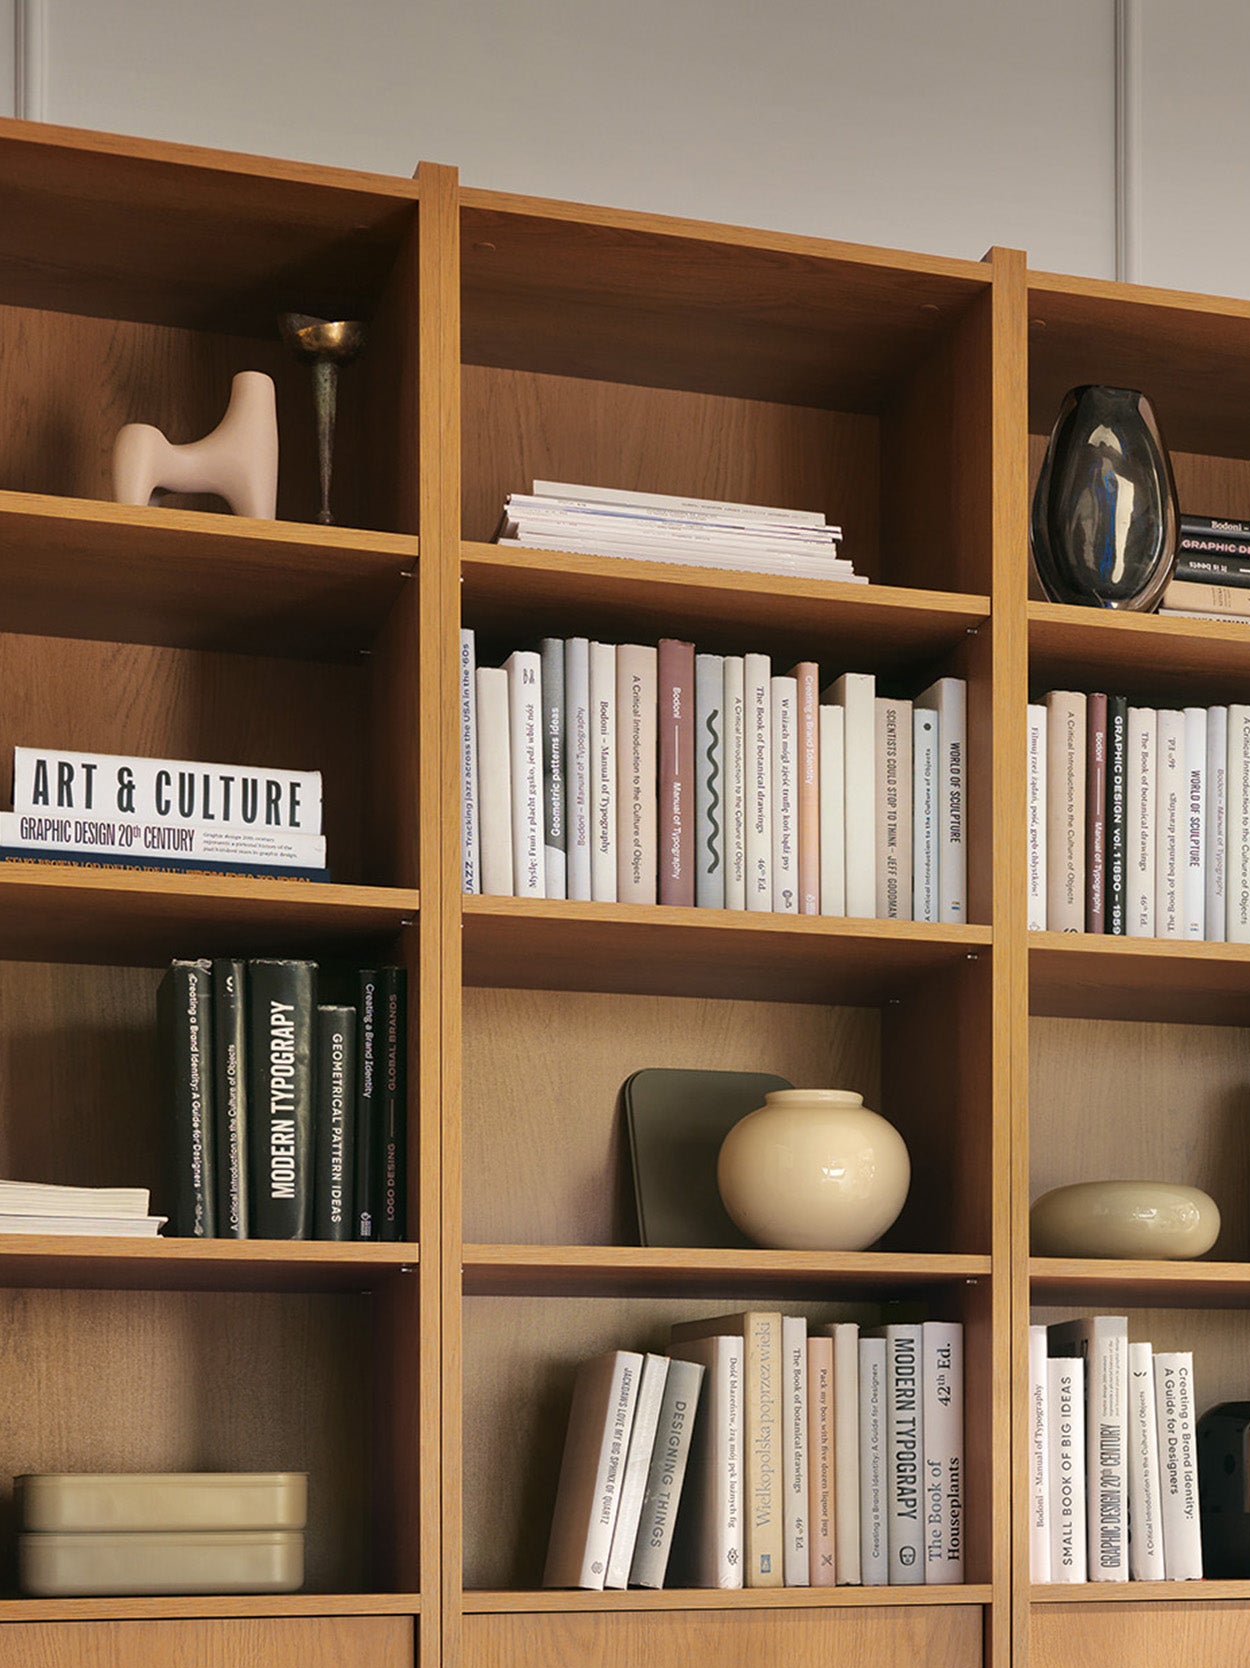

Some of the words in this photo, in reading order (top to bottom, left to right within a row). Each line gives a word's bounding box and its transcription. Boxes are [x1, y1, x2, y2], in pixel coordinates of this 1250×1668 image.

[1211, 521, 1242, 532] Bodoni
[1181, 539, 1237, 553] GRAPHIC
[1189, 561, 1212, 571] beets
[1212, 564, 1220, 572] is
[1220, 565, 1227, 573] It
[632, 675, 641, 683] A
[756, 686, 765, 705] The
[632, 684, 642, 718] Critical
[672, 687, 682, 719] Bodoni
[756, 706, 765, 731] Book
[549, 707, 560, 735] ideas
[756, 732, 765, 744] of
[886, 709, 897, 757] SCIENTISTS
[551, 737, 562, 782] patterns
[632, 718, 642, 774] Introduction
[950, 742, 961, 775] WORLD
[1114, 715, 1123, 773] GRAPHIC
[632, 775, 641, 785] to
[756, 744, 766, 789] botanical
[886, 758, 897, 785] COULD
[950, 776, 961, 789] OF
[32, 759, 98, 810] ART
[117, 766, 136, 814] &
[155, 770, 302, 828] CULTURE
[632, 786, 642, 802] the
[672, 781, 682, 815] Manual
[887, 786, 897, 809] STOP
[1113, 775, 1123, 824] DESIGN
[1190, 770, 1201, 802] WORLD
[550, 783, 561, 837] Geometric
[632, 802, 642, 837] Culture
[672, 814, 682, 826] of
[755, 790, 766, 834] drawings
[887, 811, 897, 821] TO
[949, 790, 961, 844] SCULPTURE
[1190, 803, 1201, 814] OF
[20, 816, 72, 843] GRAPHIC
[74, 820, 116, 846] DESIGN
[143, 825, 195, 852] CENTURY
[633, 837, 642, 848] of
[1113, 828, 1122, 850] vol.
[1189, 816, 1201, 867] SCULPTURE
[630, 849, 643, 884] Objects
[671, 826, 682, 880] Typography
[887, 855, 898, 876] JEFF
[1113, 860, 1122, 892] 1890
[887, 878, 898, 919] GOODMAN
[1112, 904, 1121, 935] 1959
[363, 983, 375, 1024] Creating
[270, 1000, 295, 1114] TYPOGRAPY
[364, 1031, 374, 1059] Brand
[332, 1033, 343, 1123] GEOMETRICAL
[362, 1060, 374, 1098] Identity
[271, 1119, 295, 1198] MODERN
[331, 1127, 343, 1181] PATTERN
[331, 1185, 342, 1223] IDEAS
[754, 1321, 771, 1363] wieki
[618, 1367, 633, 1408] JACKDAWS
[894, 1338, 916, 1411] MODERN
[1164, 1367, 1175, 1377] A
[759, 1363, 775, 1424] poprzez
[1060, 1376, 1072, 1418] IDEAS
[1164, 1379, 1176, 1415] Guide
[1178, 1367, 1190, 1419] Creating
[613, 1428, 624, 1441] MY
[614, 1408, 627, 1428] LOVE
[1060, 1423, 1072, 1447] BIG
[1166, 1418, 1177, 1434] for
[1181, 1421, 1189, 1430] a
[610, 1441, 622, 1455] BIG
[661, 1400, 687, 1485] DESIGNING
[1099, 1423, 1121, 1467] CENTURY
[1181, 1433, 1193, 1468] Brand
[606, 1455, 620, 1484] SPHINX
[754, 1425, 775, 1529] Wielkopolska
[895, 1416, 918, 1520] TYPOGRAPY
[926, 1459, 942, 1478] of
[1061, 1452, 1072, 1471] OF
[1166, 1437, 1179, 1495] Designers
[605, 1484, 615, 1494] OF
[927, 1482, 942, 1524] Book
[1061, 1476, 1073, 1516] BOOK
[1100, 1489, 1121, 1524] DESIGN
[1183, 1470, 1195, 1520] Identity:
[599, 1495, 613, 1525] QUARTZ
[650, 1492, 671, 1547] THINGS
[947, 1457, 962, 1560] Houseplants
[927, 1529, 943, 1562] The
[1062, 1522, 1073, 1566] SMALL
[1100, 1526, 1121, 1568] GRAPHIC
